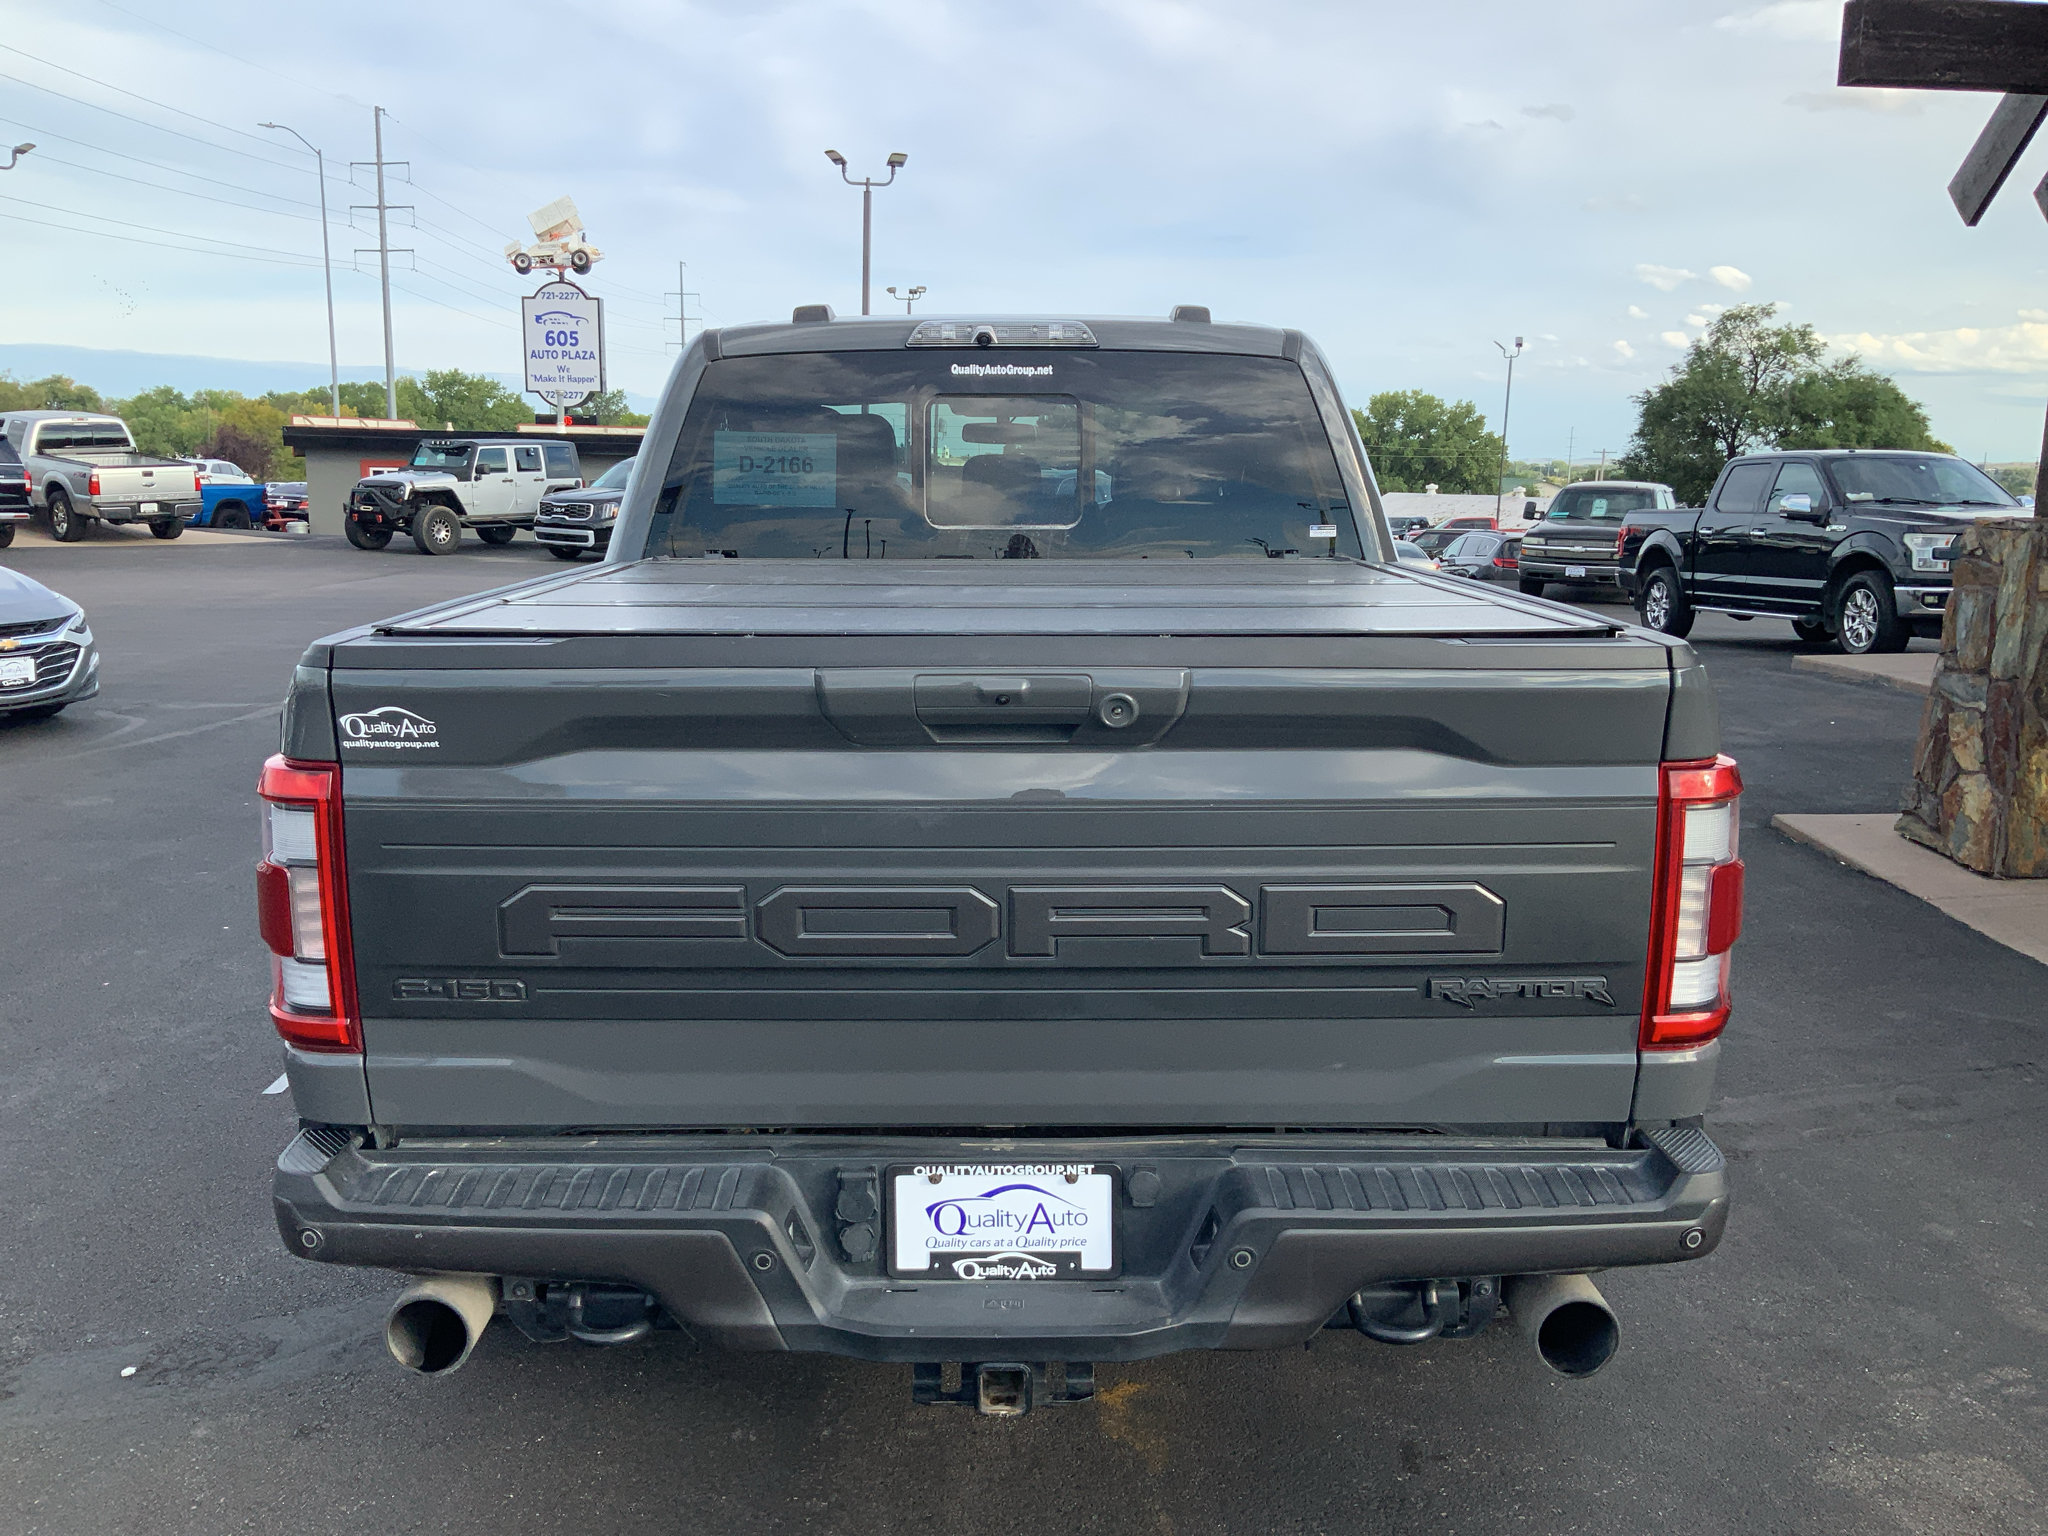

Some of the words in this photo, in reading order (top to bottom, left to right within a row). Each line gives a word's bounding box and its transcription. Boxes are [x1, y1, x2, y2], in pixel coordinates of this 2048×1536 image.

[541, 291, 580, 300] 721-2277
[545, 330, 579, 347] 605
[530, 349, 559, 360] AUTO
[561, 350, 596, 360] PLAZA
[556, 364, 571, 373] We
[951, 363, 1053, 377] QualityAutoGroup.net
[558, 374, 565, 383] It
[739, 455, 814, 474] D-2166
[342, 739, 440, 749] qualityautogroup.net
[496, 882, 1507, 961] FORD
[393, 977, 529, 1001] F-150
[1425, 975, 1617, 1010] RAPTOR
[913, 1164, 1095, 1176] QUALITYAUTOGROUP.NET
[925, 1236, 967, 1249] Quality
[969, 1238, 991, 1248] cars
[993, 1237, 1006, 1248] at
[1007, 1238, 1014, 1247] a
[1015, 1235, 1058, 1249] Quality
[1059, 1237, 1087, 1249] price
